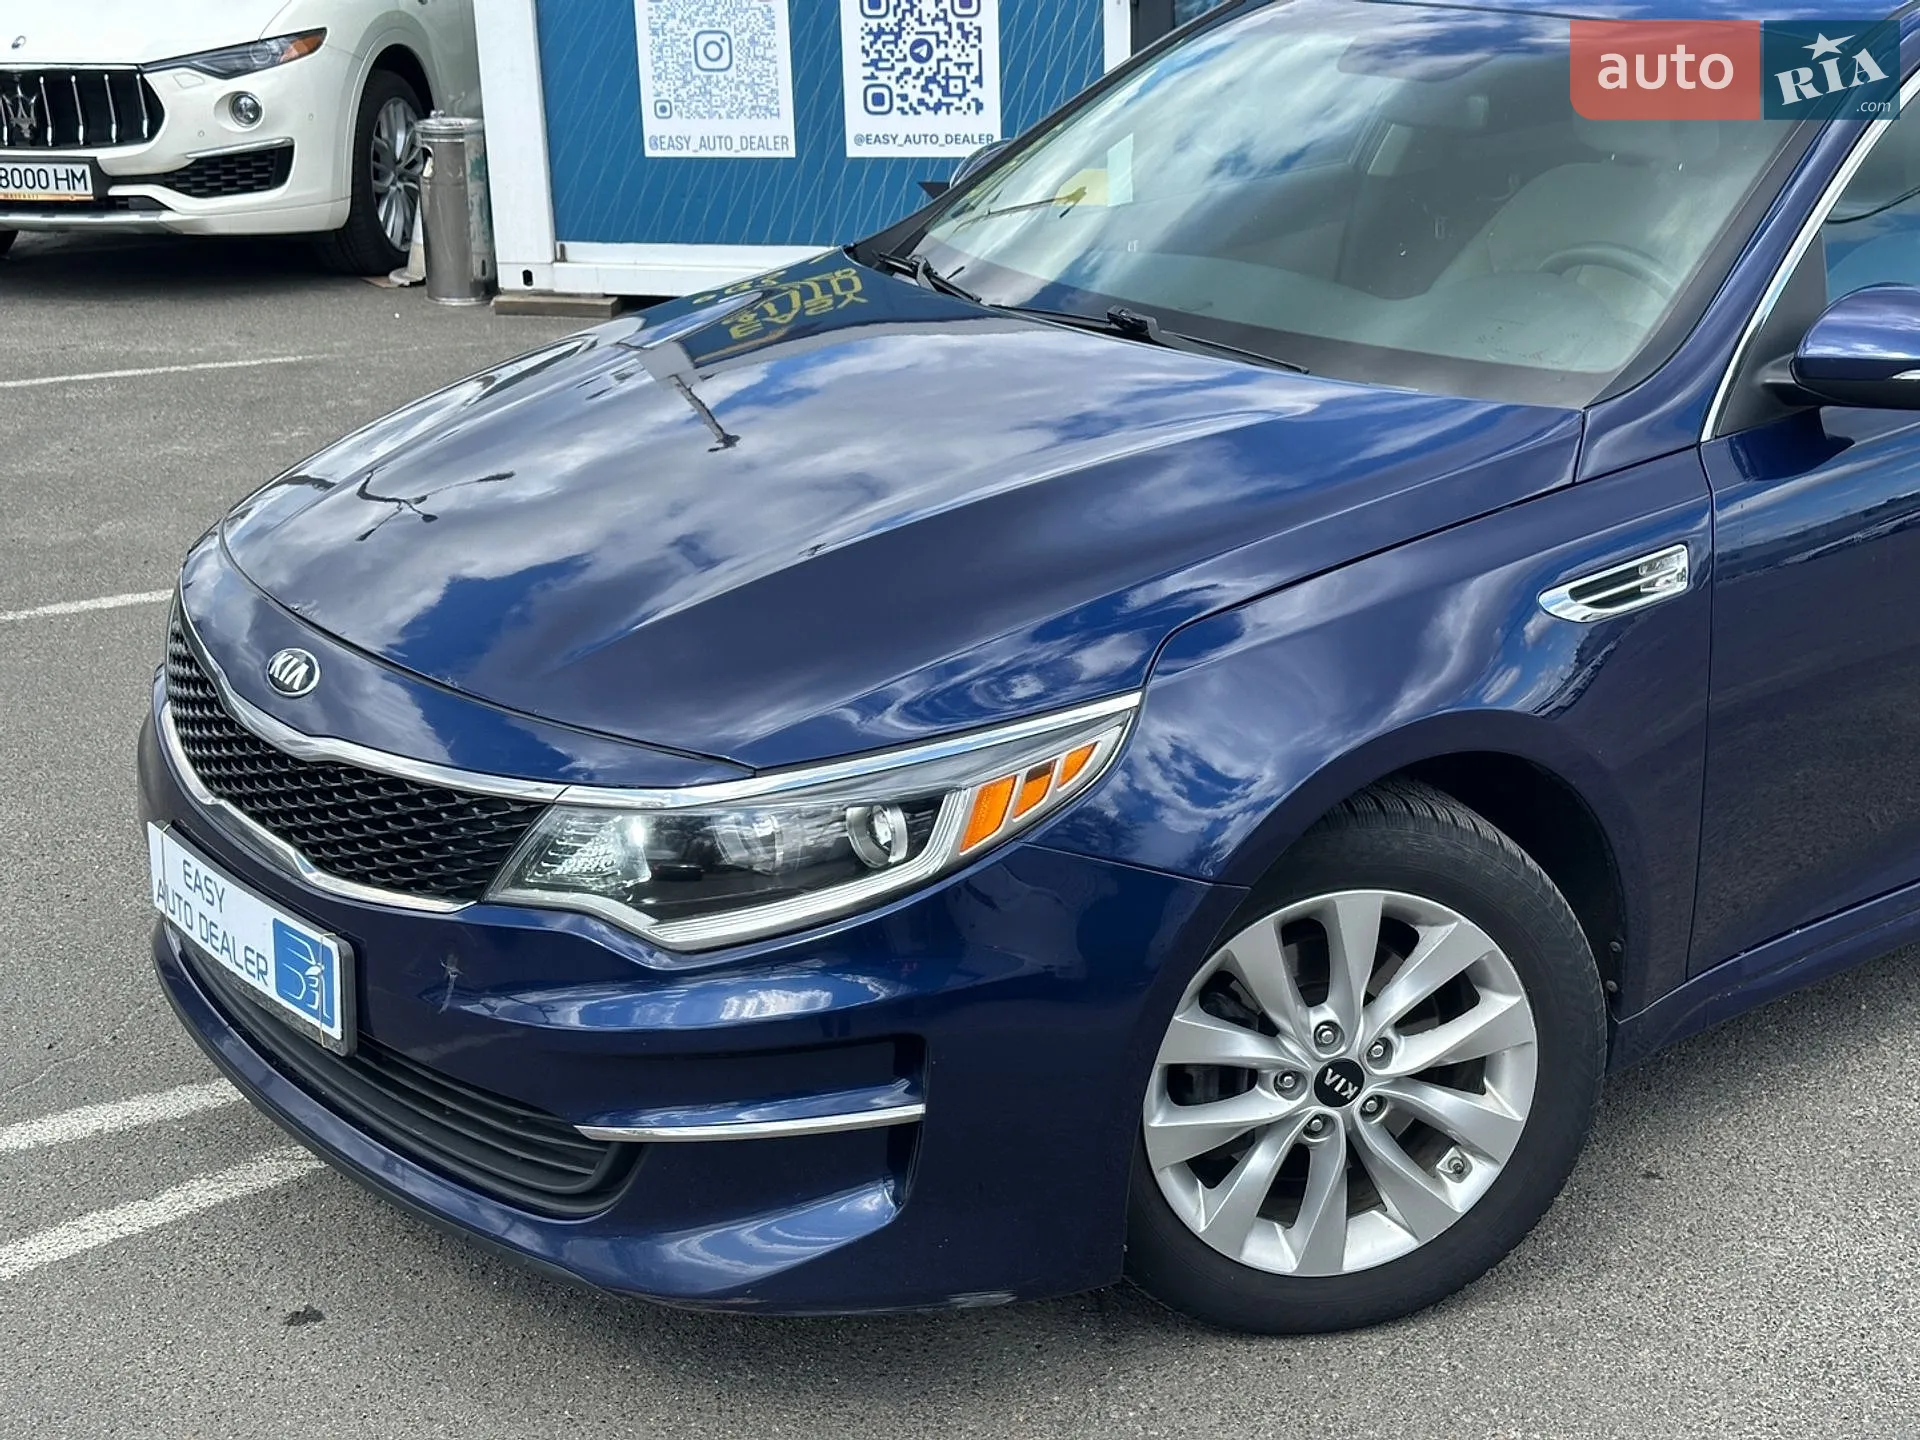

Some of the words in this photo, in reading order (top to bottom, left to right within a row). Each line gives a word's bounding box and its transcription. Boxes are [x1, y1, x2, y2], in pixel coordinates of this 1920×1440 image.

[648, 134, 790, 153] @EASY_AUTO_DEALER
[853, 132, 995, 148] @EASY_AUTO_DEALER
[53, 168, 88, 191] HM
[269, 651, 310, 691] KIA
[182, 859, 226, 913] EASY
[156, 878, 194, 932] AUTO
[198, 911, 269, 987] DEALER
[1324, 1067, 1359, 1100] KIA
